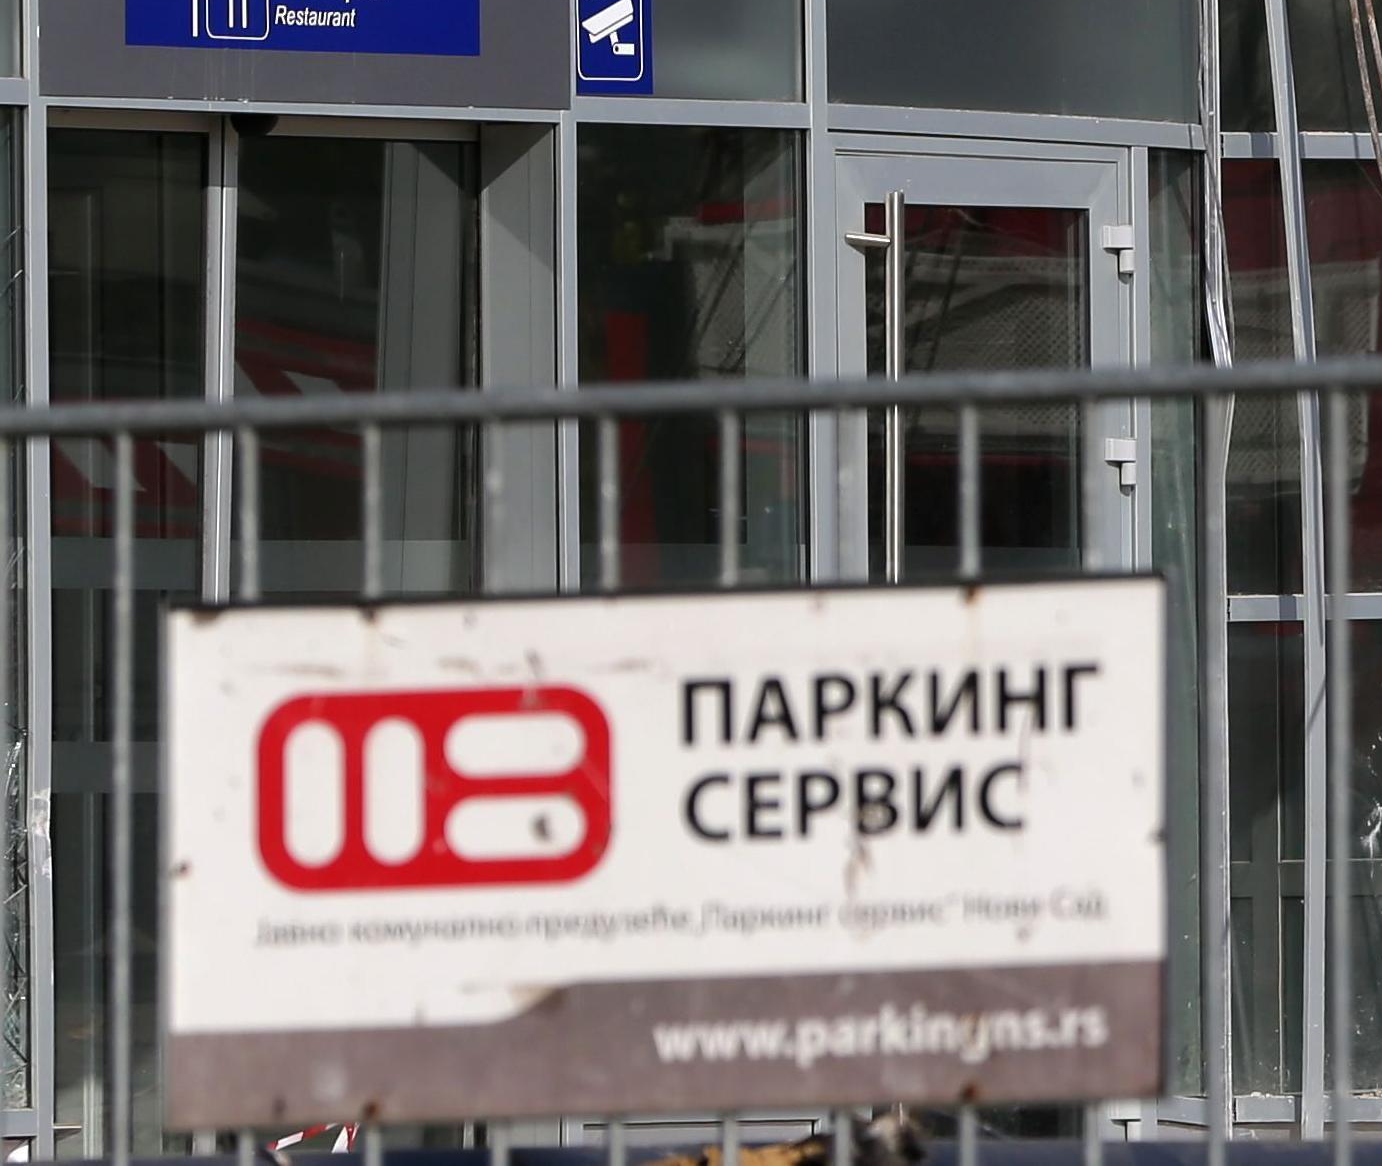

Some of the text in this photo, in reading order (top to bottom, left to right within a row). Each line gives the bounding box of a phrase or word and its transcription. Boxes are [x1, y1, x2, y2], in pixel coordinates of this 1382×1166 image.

[275, 5, 356, 27] Restaurant
[680, 663, 1100, 748] ПАРКИНГ
[683, 761, 1025, 844] СЕРВИС
[652, 1002, 1110, 1069] www.parkingns.rs
